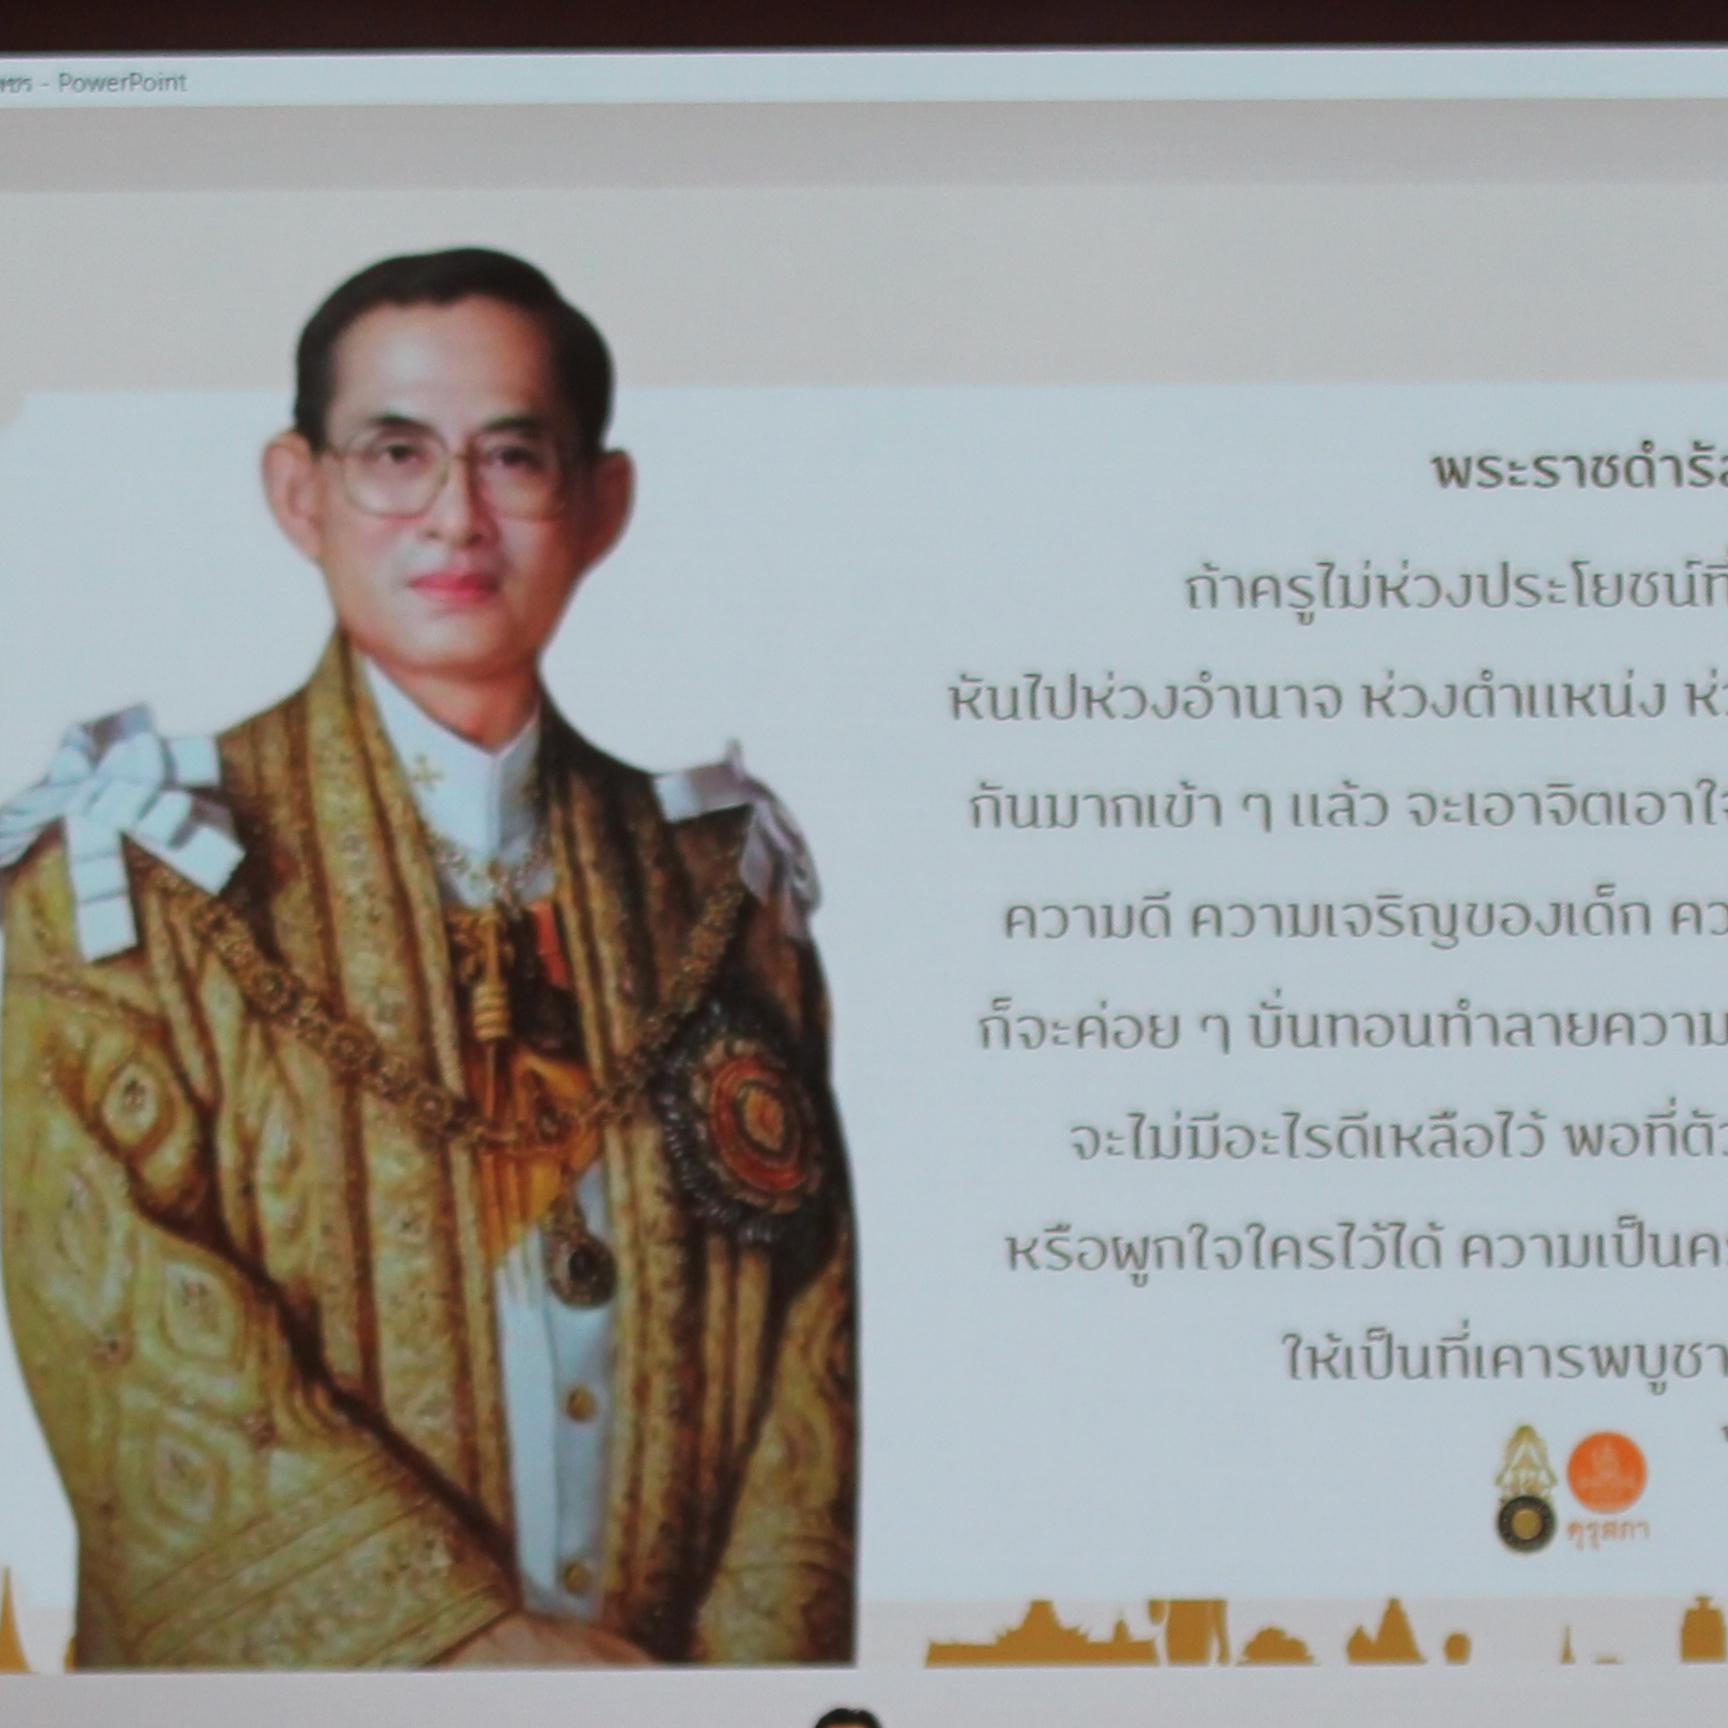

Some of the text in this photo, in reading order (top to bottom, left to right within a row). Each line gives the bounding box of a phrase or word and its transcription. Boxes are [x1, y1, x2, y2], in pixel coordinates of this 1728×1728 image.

[58, 71, 187, 93] PowerPoint
[947, 669, 1343, 721] หันไปห่วงอำนาจ
[1360, 668, 1666, 719] ห่วงตำแหน่ง
[969, 780, 1223, 829] กันมากเข้า
[1291, 779, 1389, 827] แล้ว
[1004, 890, 1172, 939] ความดี
[1190, 882, 1651, 950] ความเจริญของเด็ก
[978, 996, 1180, 1050] ก็จะค่อย
[1070, 1109, 1547, 1160] จะไม่มีอะไรดีเหลือไว้
[1004, 1220, 1445, 1288] หรือผูกใจใครไว้ได้
